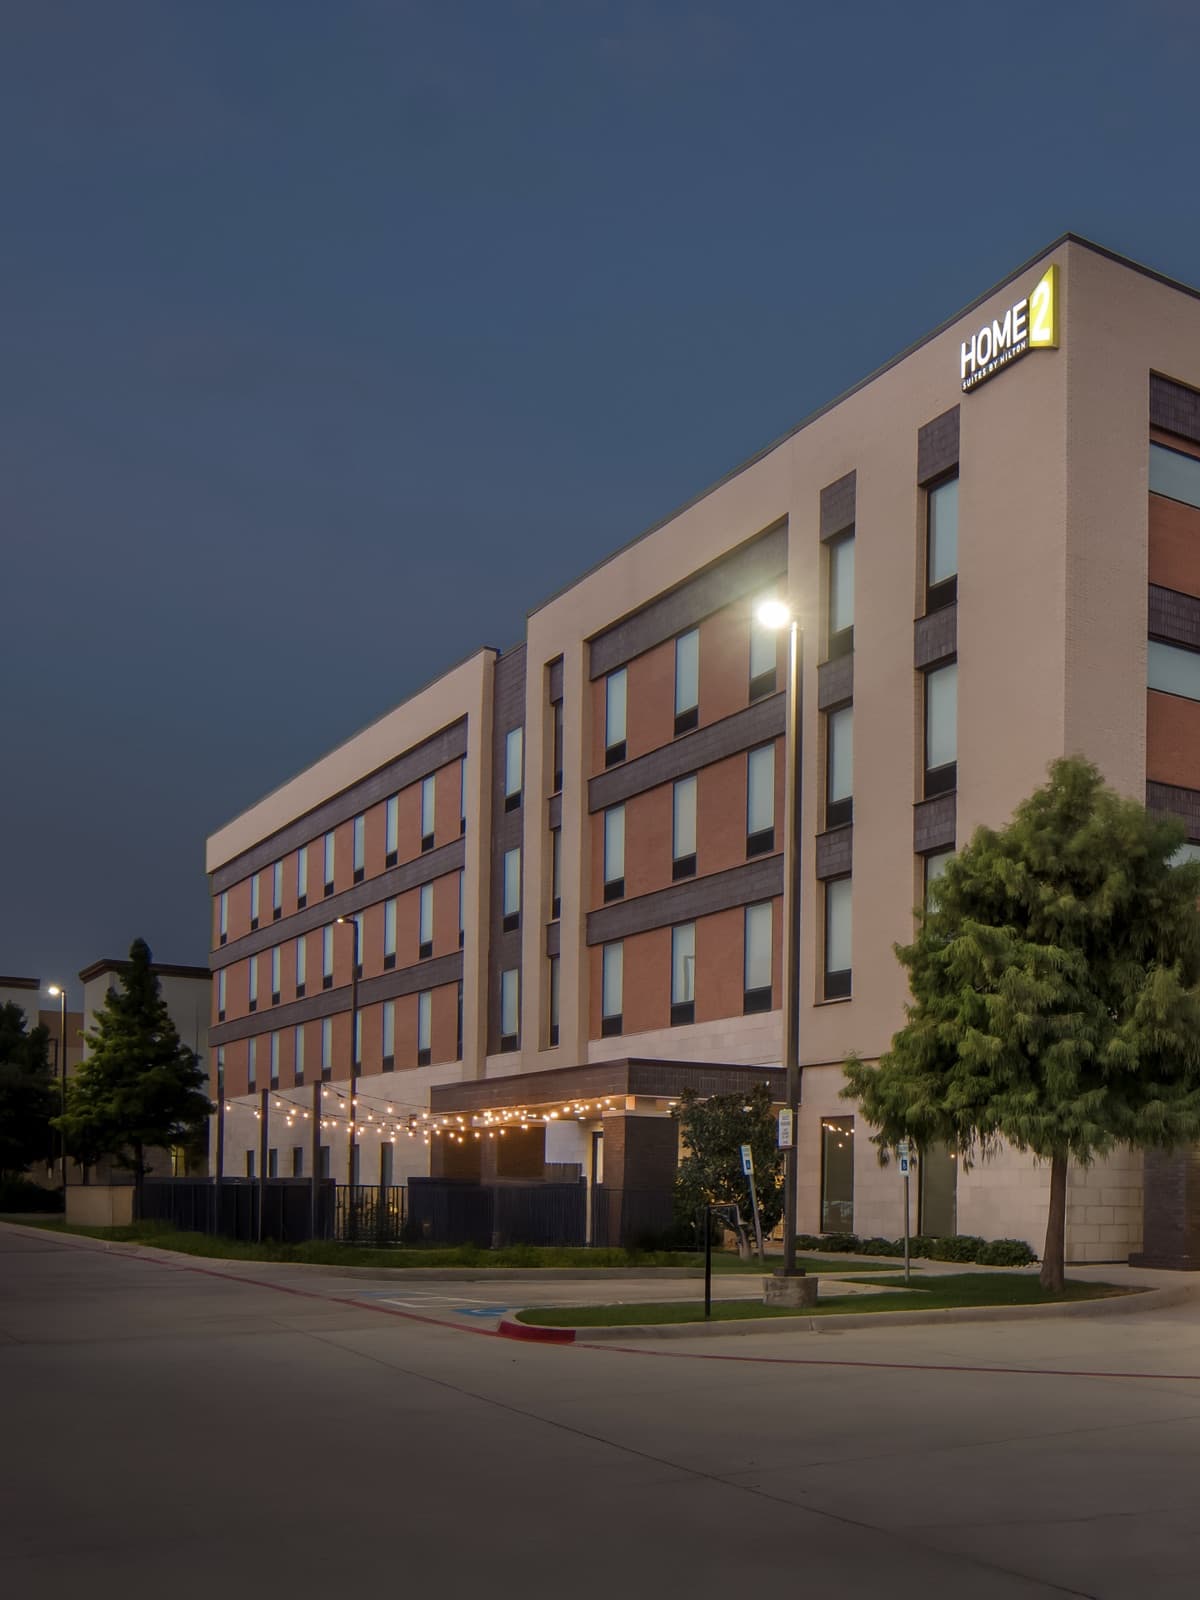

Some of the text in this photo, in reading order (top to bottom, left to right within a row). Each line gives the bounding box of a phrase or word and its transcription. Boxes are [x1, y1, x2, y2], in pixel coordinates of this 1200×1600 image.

[960, 280, 1051, 379] HOME 2
[962, 341, 1026, 390] SUITES BY HILTON
